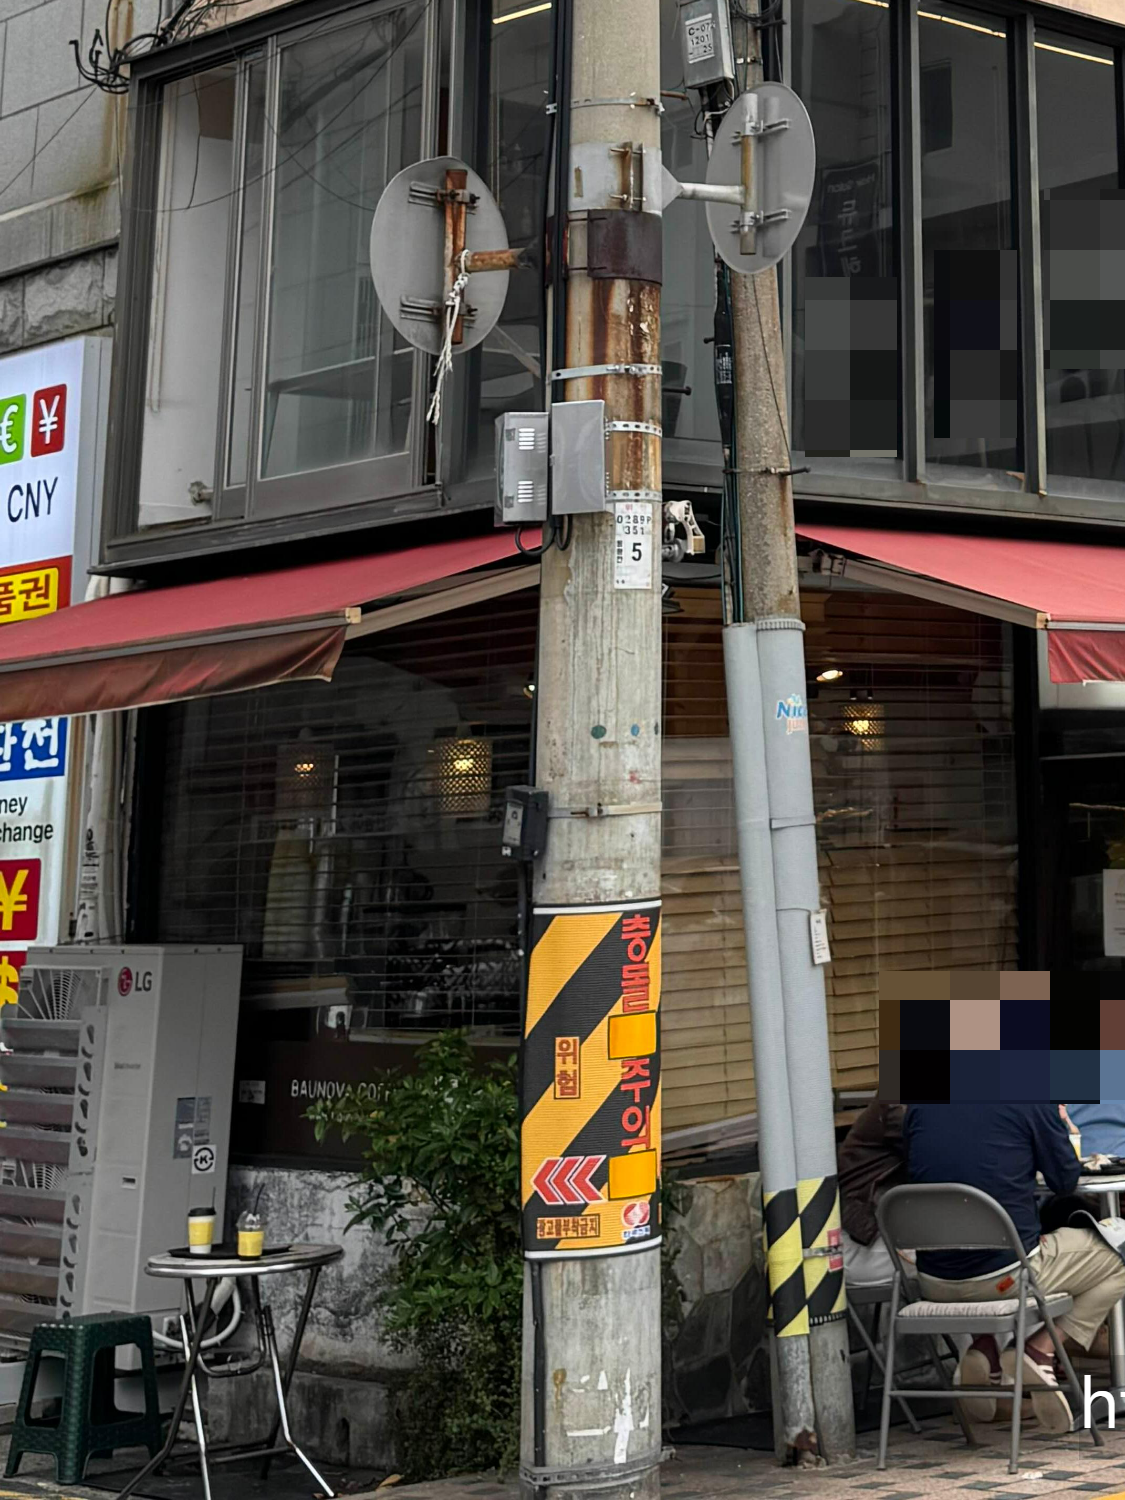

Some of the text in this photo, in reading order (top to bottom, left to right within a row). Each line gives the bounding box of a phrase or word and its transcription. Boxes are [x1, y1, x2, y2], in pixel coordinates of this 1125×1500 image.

[8, 476, 58, 523] CNY
[623, 526, 645, 535] 351
[631, 542, 642, 561] 5
[135, 971, 153, 992] LG
[620, 1057, 650, 1149] 주의
[537, 1217, 598, 1238] 광고물부착금지
